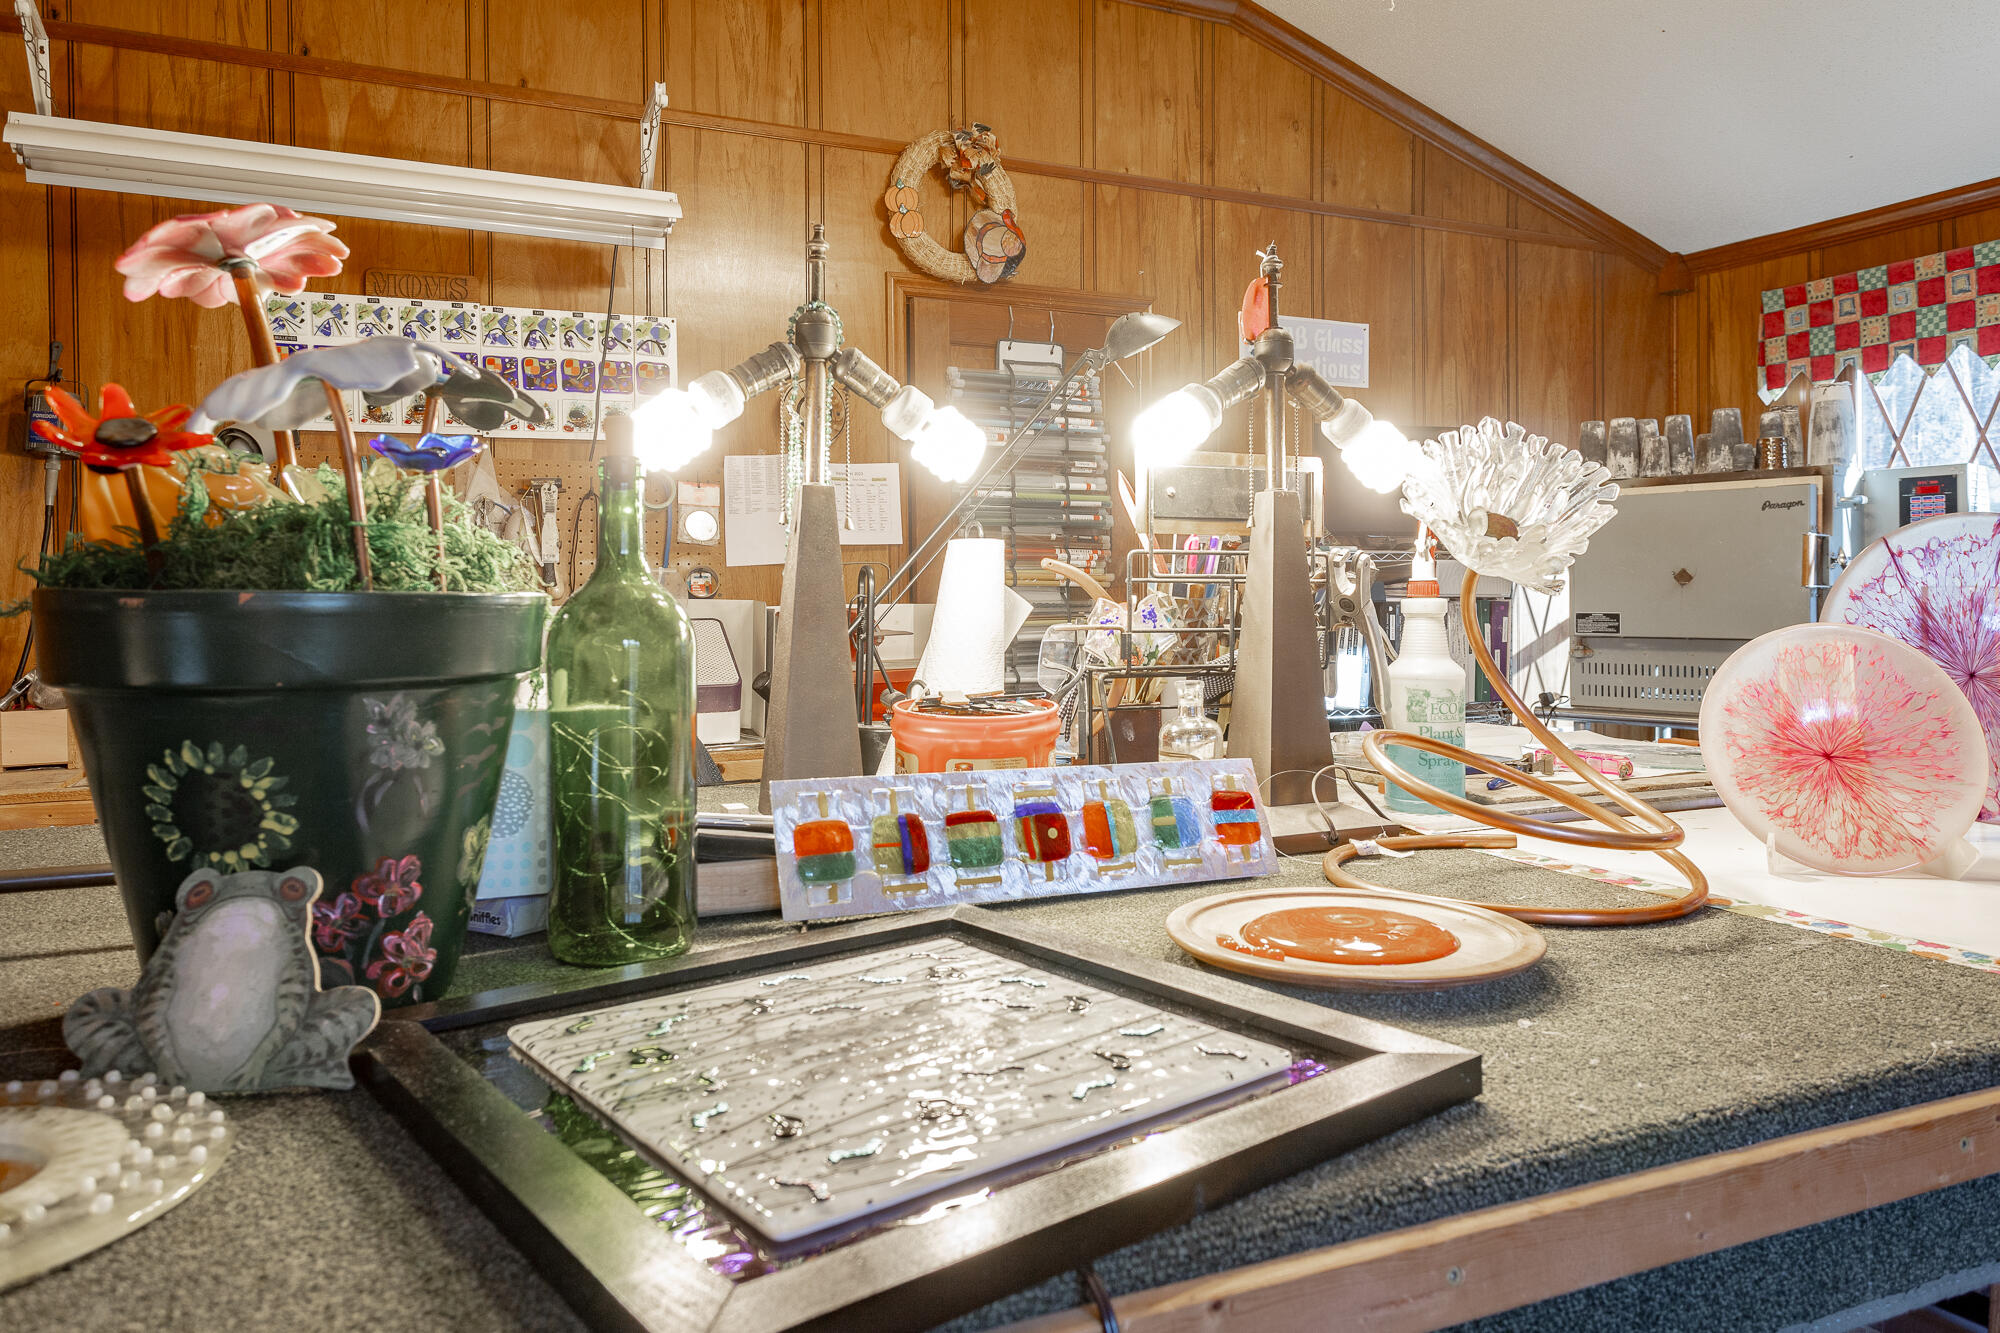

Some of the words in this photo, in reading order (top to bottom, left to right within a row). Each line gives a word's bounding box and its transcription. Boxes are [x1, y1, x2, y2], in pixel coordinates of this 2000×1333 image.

[370, 271, 468, 301] MOMS
[1315, 328, 1362, 354] Glass
[1311, 356, 1361, 379] tions
[1761, 500, 1806, 511] Paragon
[1430, 702, 1457, 714] ECO
[1418, 726, 1455, 739] Plant
[1455, 726, 1464, 738] &
